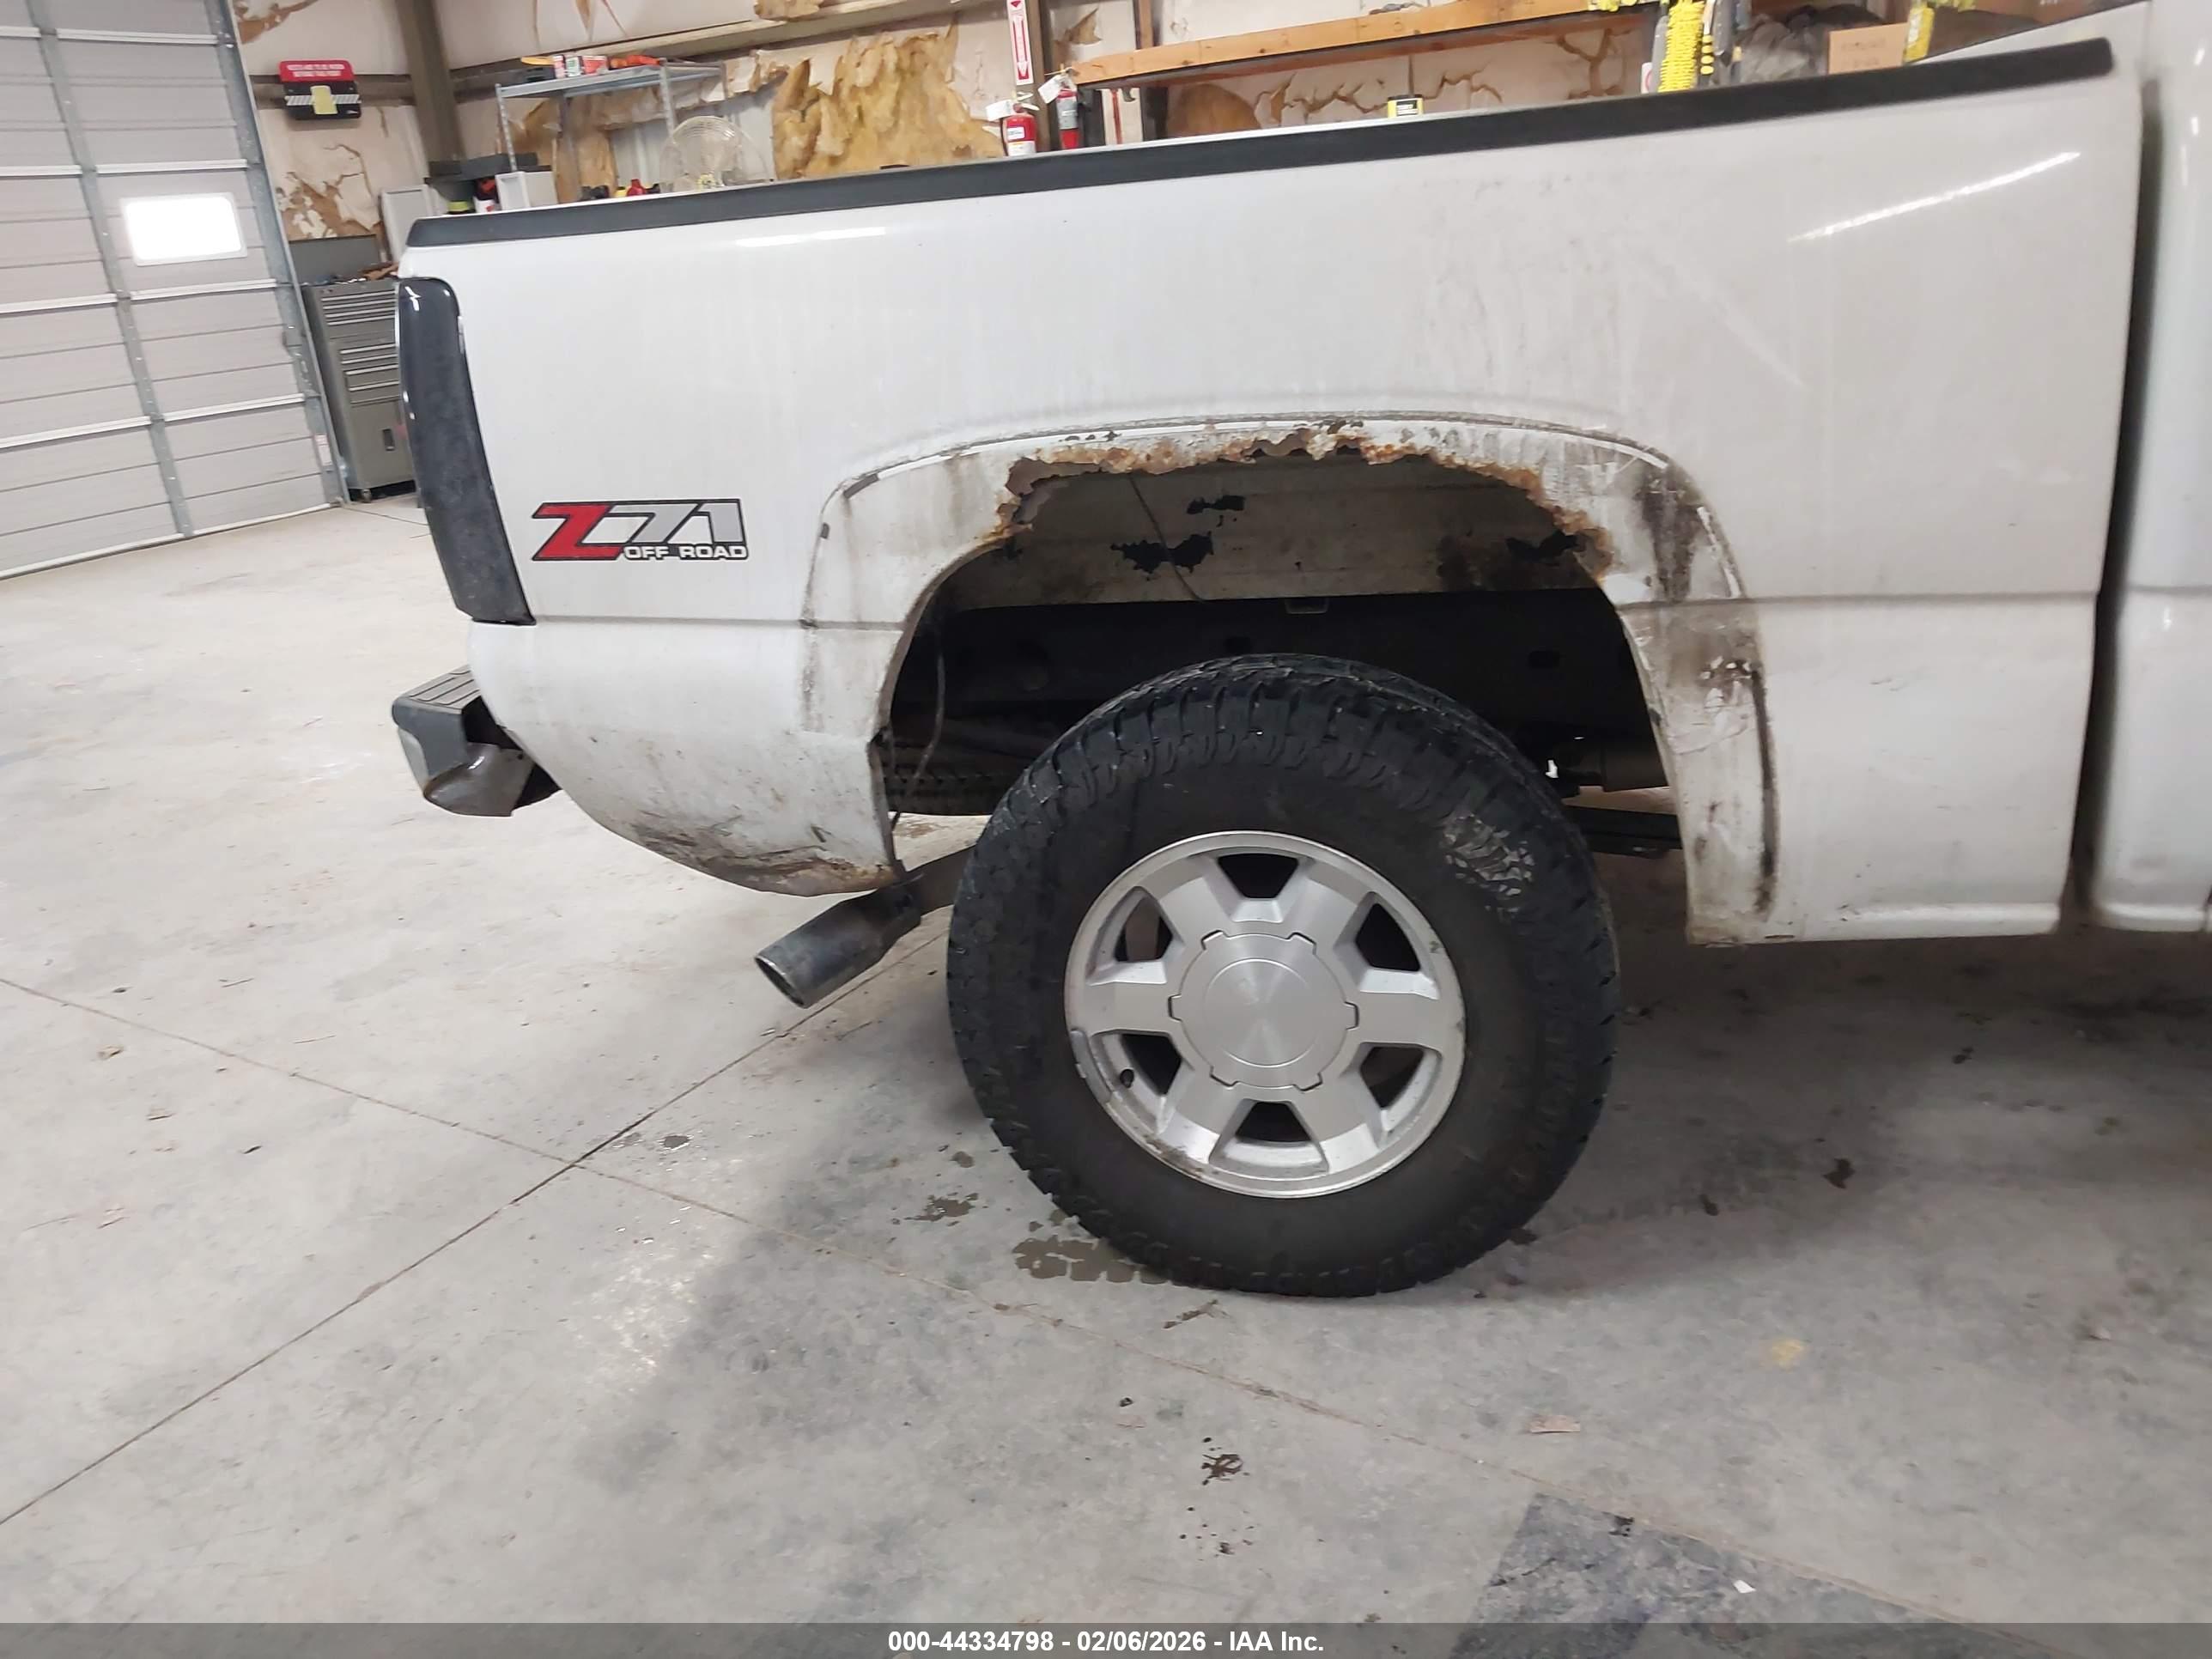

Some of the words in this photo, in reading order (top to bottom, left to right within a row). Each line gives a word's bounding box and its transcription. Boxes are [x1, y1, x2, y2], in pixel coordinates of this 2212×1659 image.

[532, 498, 746, 561] Z71
[623, 545, 669, 559] OFF
[679, 545, 748, 559] ROAD
